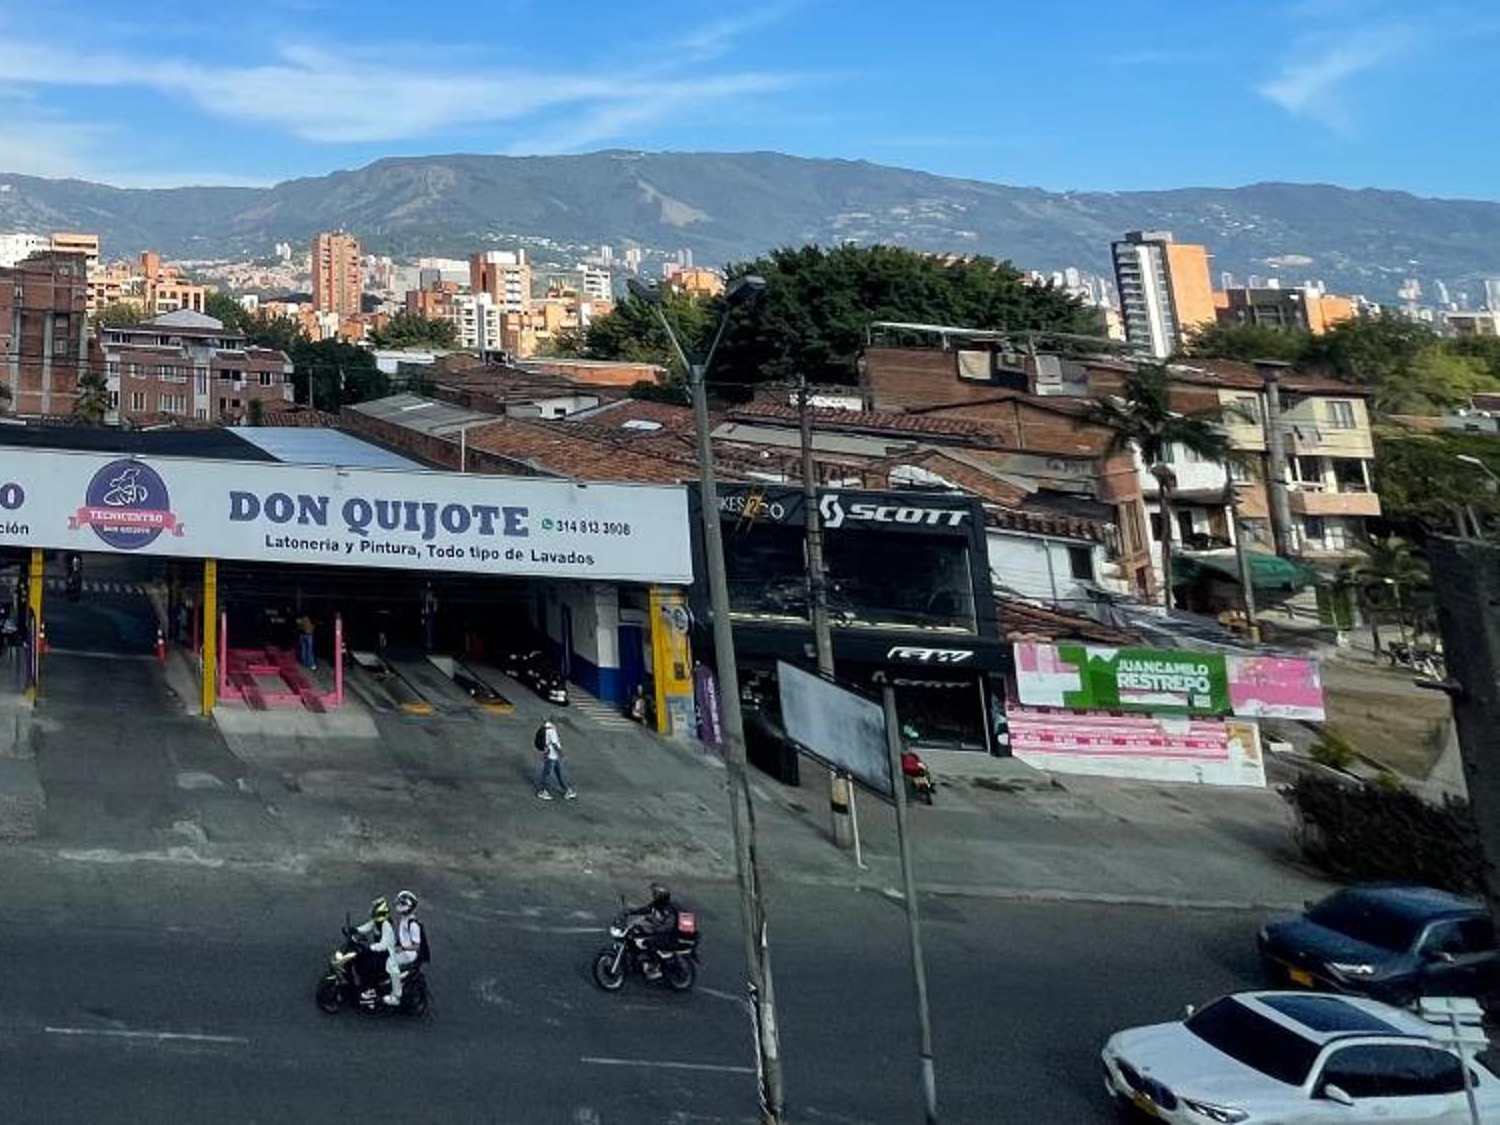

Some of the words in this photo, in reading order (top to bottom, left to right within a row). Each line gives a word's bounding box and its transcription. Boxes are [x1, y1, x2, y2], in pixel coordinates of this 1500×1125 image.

[229, 490, 330, 526] DON
[341, 497, 530, 541] QUIJOTE
[846, 503, 971, 526] SCOTT
[556, 520, 577, 533] 314
[344, 540, 354, 556] y
[360, 540, 422, 559] Pintura,
[426, 544, 465, 559] Todo
[469, 546, 499, 563] tipo
[505, 547, 524, 562] de
[530, 549, 595, 565] Lavados
[1116, 672, 1211, 693] RESTREPO
